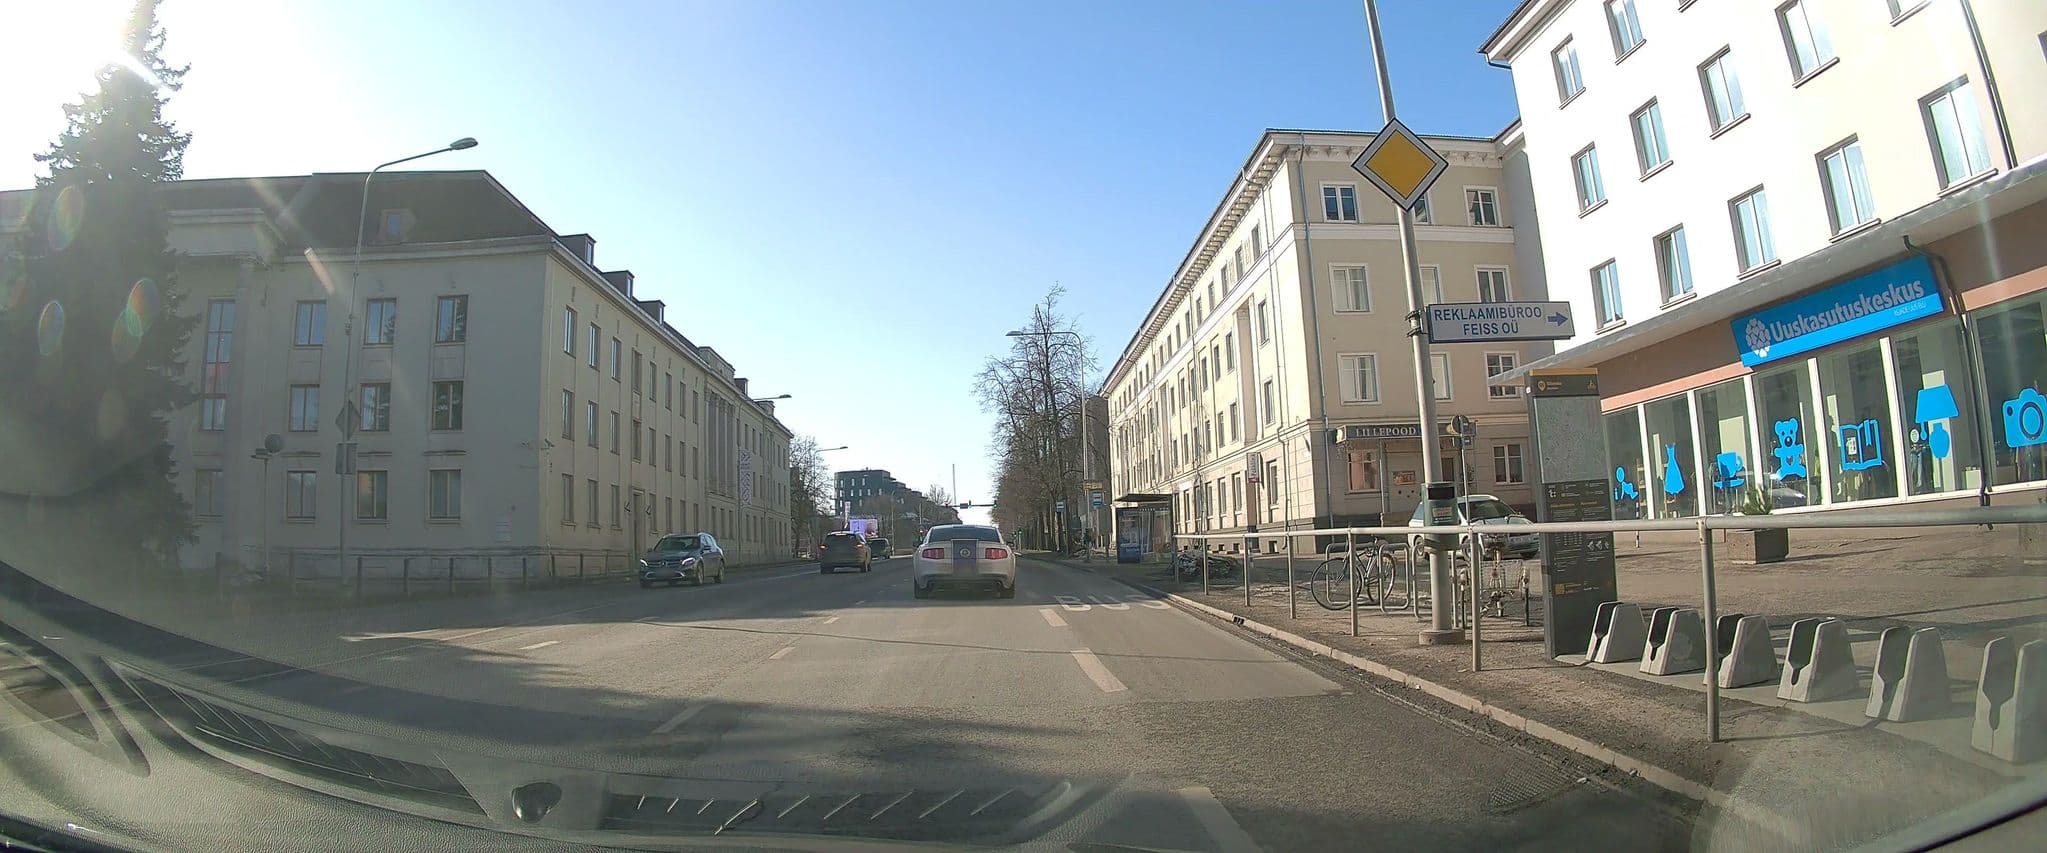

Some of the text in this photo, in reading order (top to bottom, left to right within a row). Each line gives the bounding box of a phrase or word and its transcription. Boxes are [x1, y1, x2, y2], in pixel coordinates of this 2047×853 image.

[1434, 304, 1542, 321] REKLAAMIBÜROO
[1771, 280, 1924, 341] Uuskasutuskeskus
[1463, 319, 1519, 336] FEISS OÜ
[1356, 426, 1417, 437] LILLEPOOD
